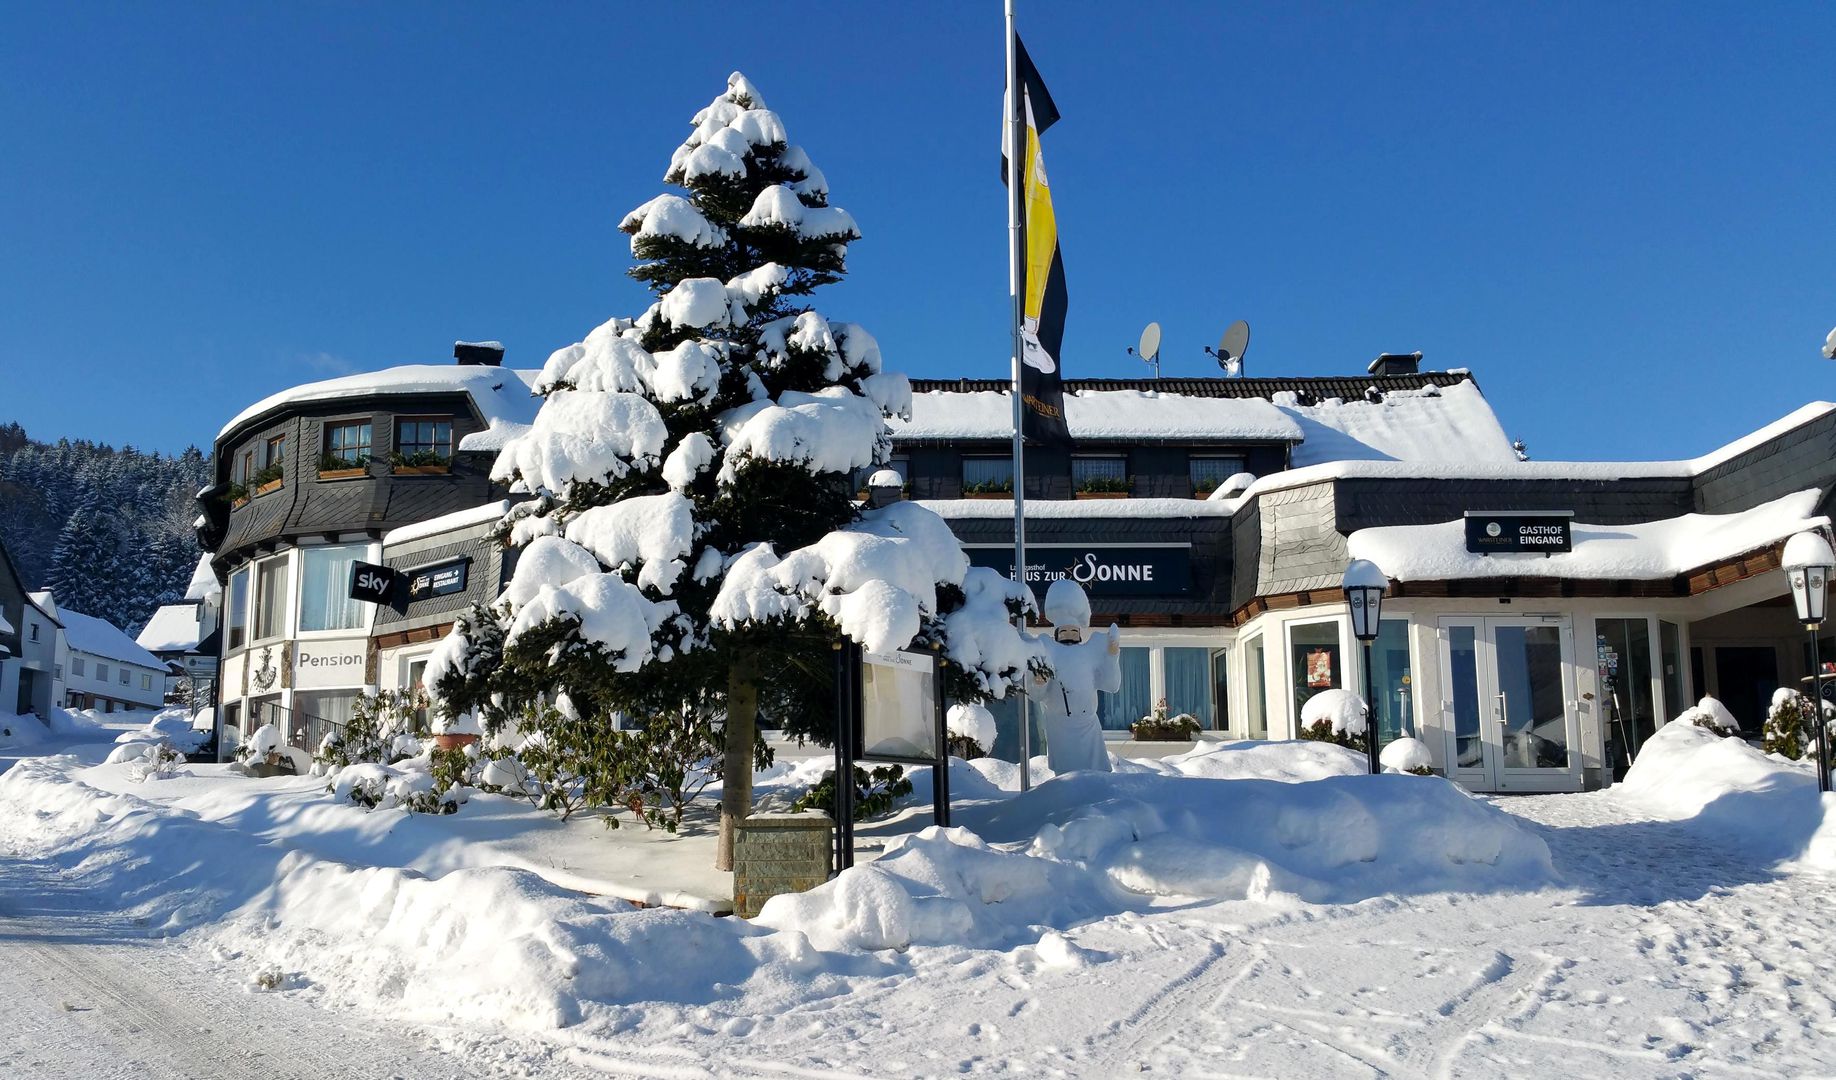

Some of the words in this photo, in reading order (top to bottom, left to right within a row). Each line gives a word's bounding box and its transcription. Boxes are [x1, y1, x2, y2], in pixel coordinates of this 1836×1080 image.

[1519, 526, 1563, 535] GASTHOF
[1519, 536, 1564, 545] EINGANG
[1009, 564, 1046, 572] Lagasthof
[1010, 571, 1040, 582] HUS
[1044, 571, 1066, 582] ZUR
[358, 571, 390, 596] sky
[299, 652, 363, 668] Pension
